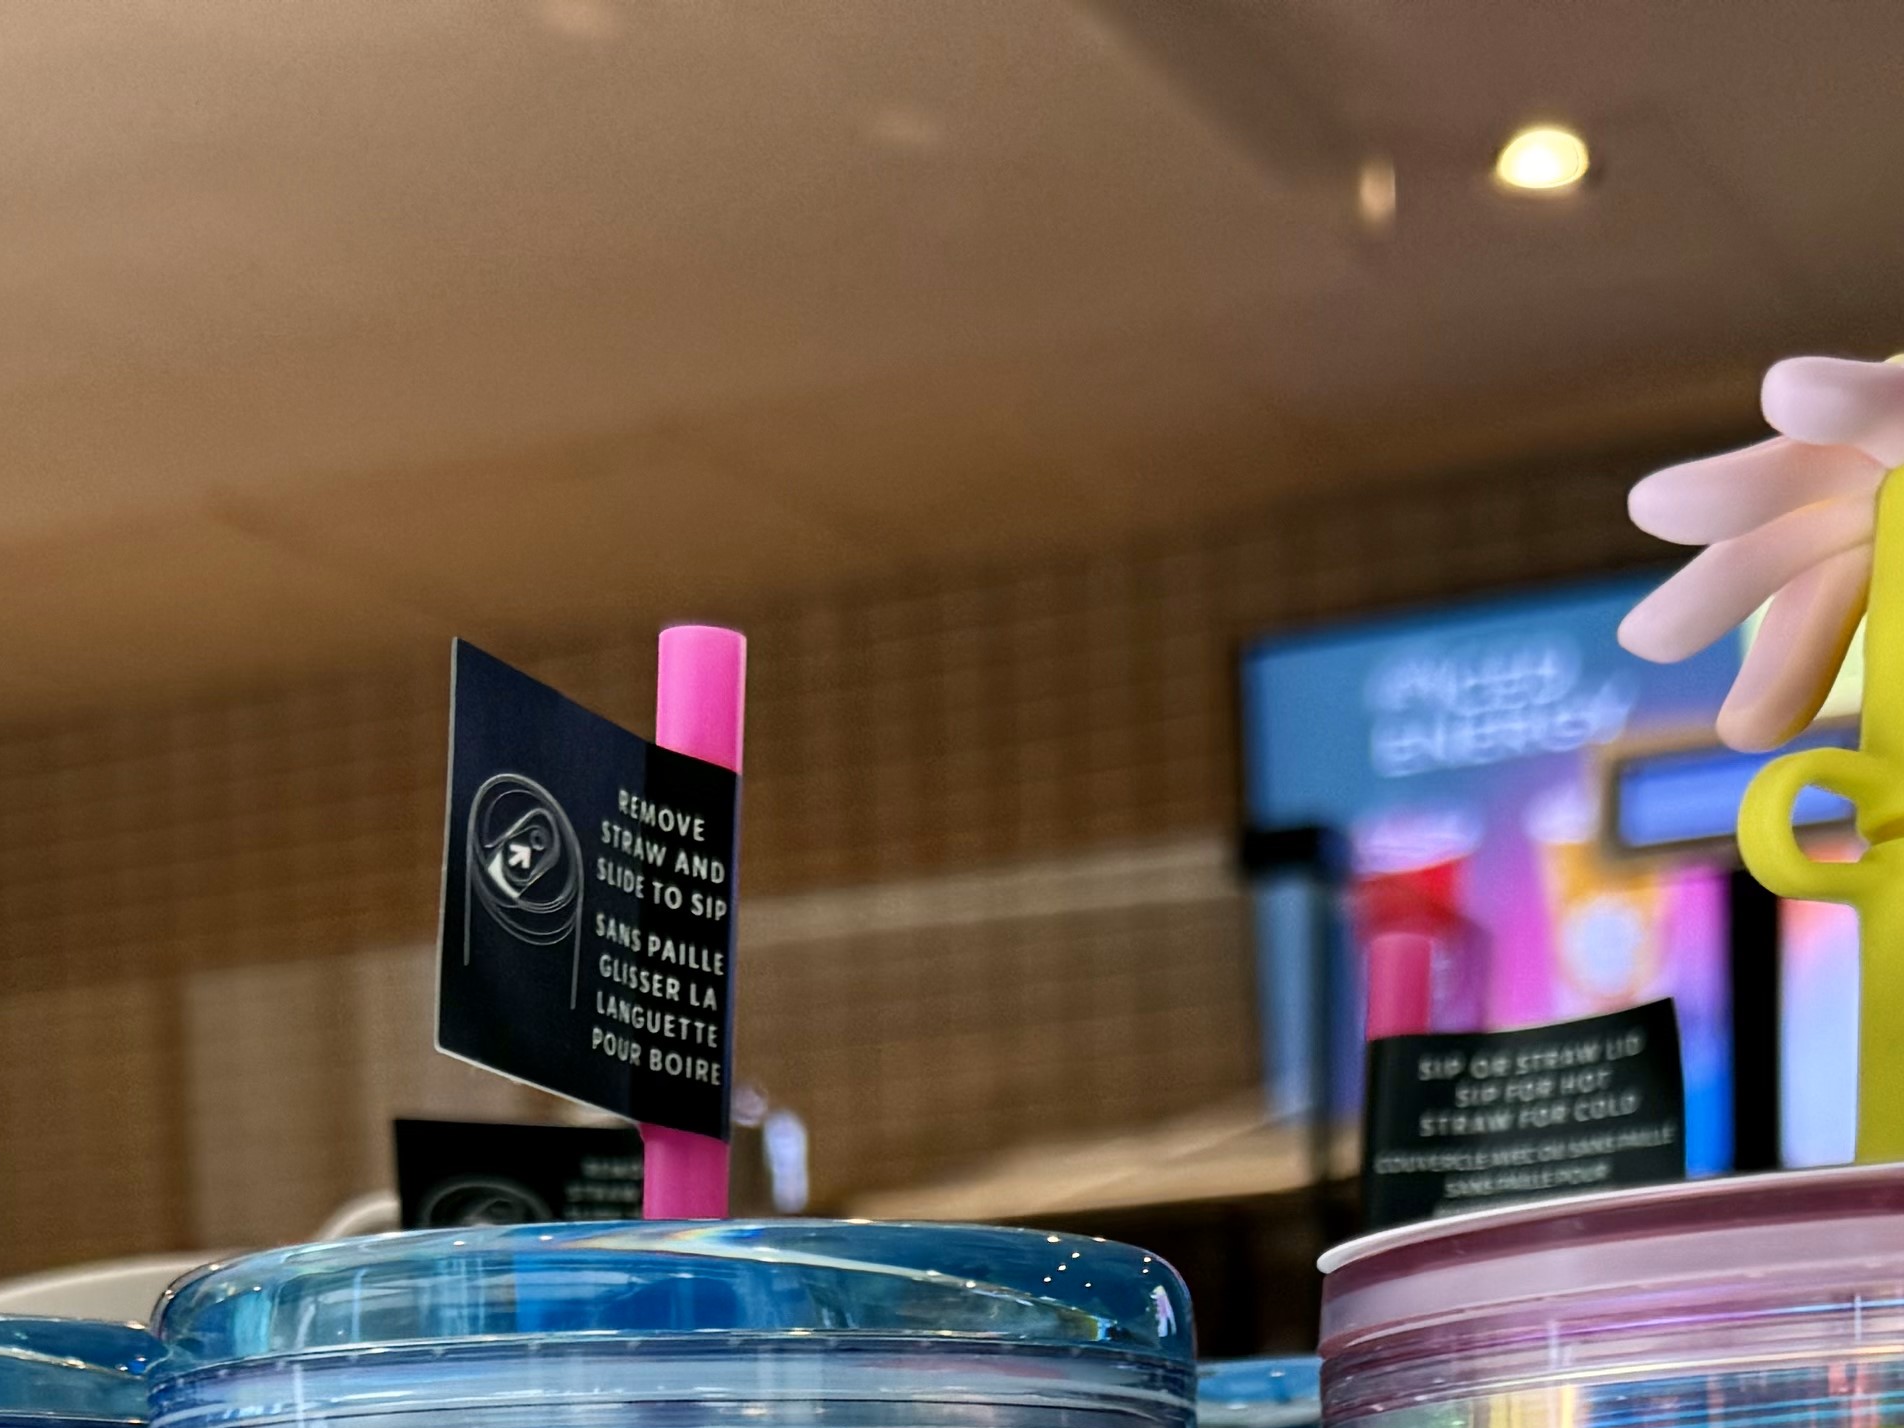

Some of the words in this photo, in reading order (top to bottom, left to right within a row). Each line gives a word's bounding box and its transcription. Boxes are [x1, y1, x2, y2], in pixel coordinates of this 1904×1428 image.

[618, 789, 705, 842] REMOVE
[601, 820, 666, 868] STRAW
[674, 851, 725, 884] AND
[596, 857, 644, 899] SLIDE
[652, 880, 683, 910] TO
[690, 892, 727, 921] SIP
[595, 912, 642, 952] SANS
[647, 934, 724, 977] PAILLE
[599, 953, 681, 1002] GLISSER
[689, 982, 718, 1012] LA
[596, 990, 718, 1049] LANGUETTE
[592, 1027, 642, 1066] POUR
[649, 1048, 721, 1086] BOIRE
[1418, 1053, 1463, 1081] SIP
[1470, 1051, 1511, 1079] OR
[1516, 1041, 1601, 1075] STRAW
[1606, 1030, 1643, 1060] LID
[1419, 1107, 1513, 1137] STRAW
[1518, 1101, 1568, 1128] FOR
[1574, 1091, 1638, 1122] COLD
[1455, 1078, 1498, 1107] SIP
[1505, 1074, 1553, 1102] FOR
[1560, 1067, 1612, 1095] HOT
